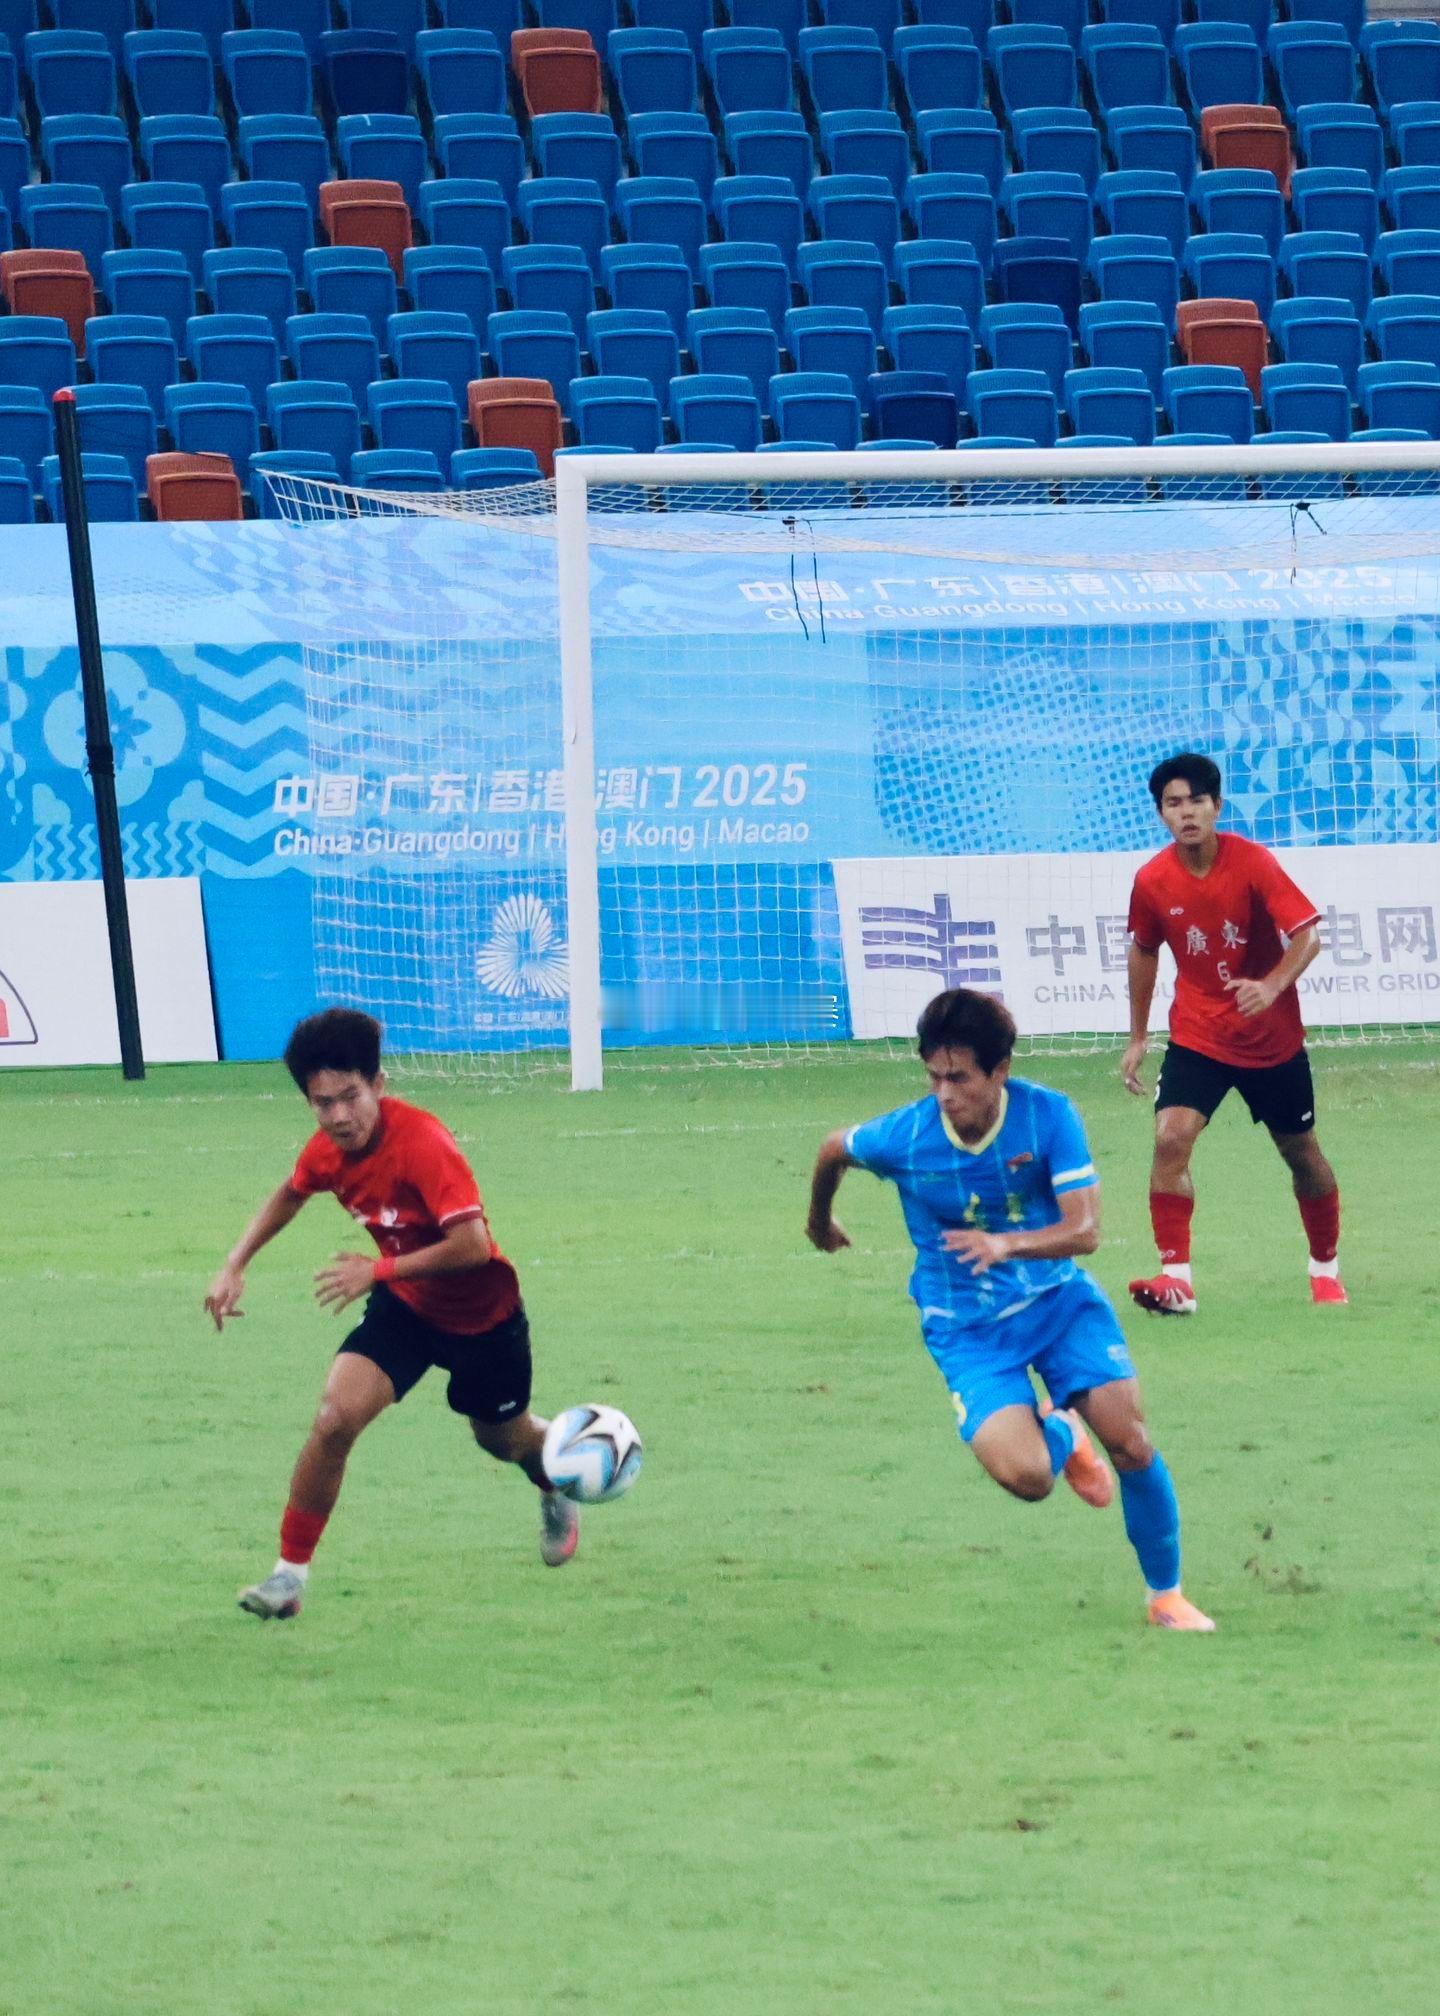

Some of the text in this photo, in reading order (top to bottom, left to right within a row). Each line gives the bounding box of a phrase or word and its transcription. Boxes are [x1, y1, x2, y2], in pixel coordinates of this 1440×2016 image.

[1247, 566, 1393, 590] 2025
[1091, 599, 1187, 614] Hong
[1190, 596, 1281, 612] Kong
[692, 763, 808, 808] 2025
[544, 823, 617, 855] Hg
[624, 819, 696, 853] Kong
[718, 816, 810, 845] Macao
[1216, 960, 1231, 982] 6
[1033, 983, 1116, 1004] CHINA
[1297, 974, 1371, 995] OWER
[1378, 972, 1440, 992] GRID
